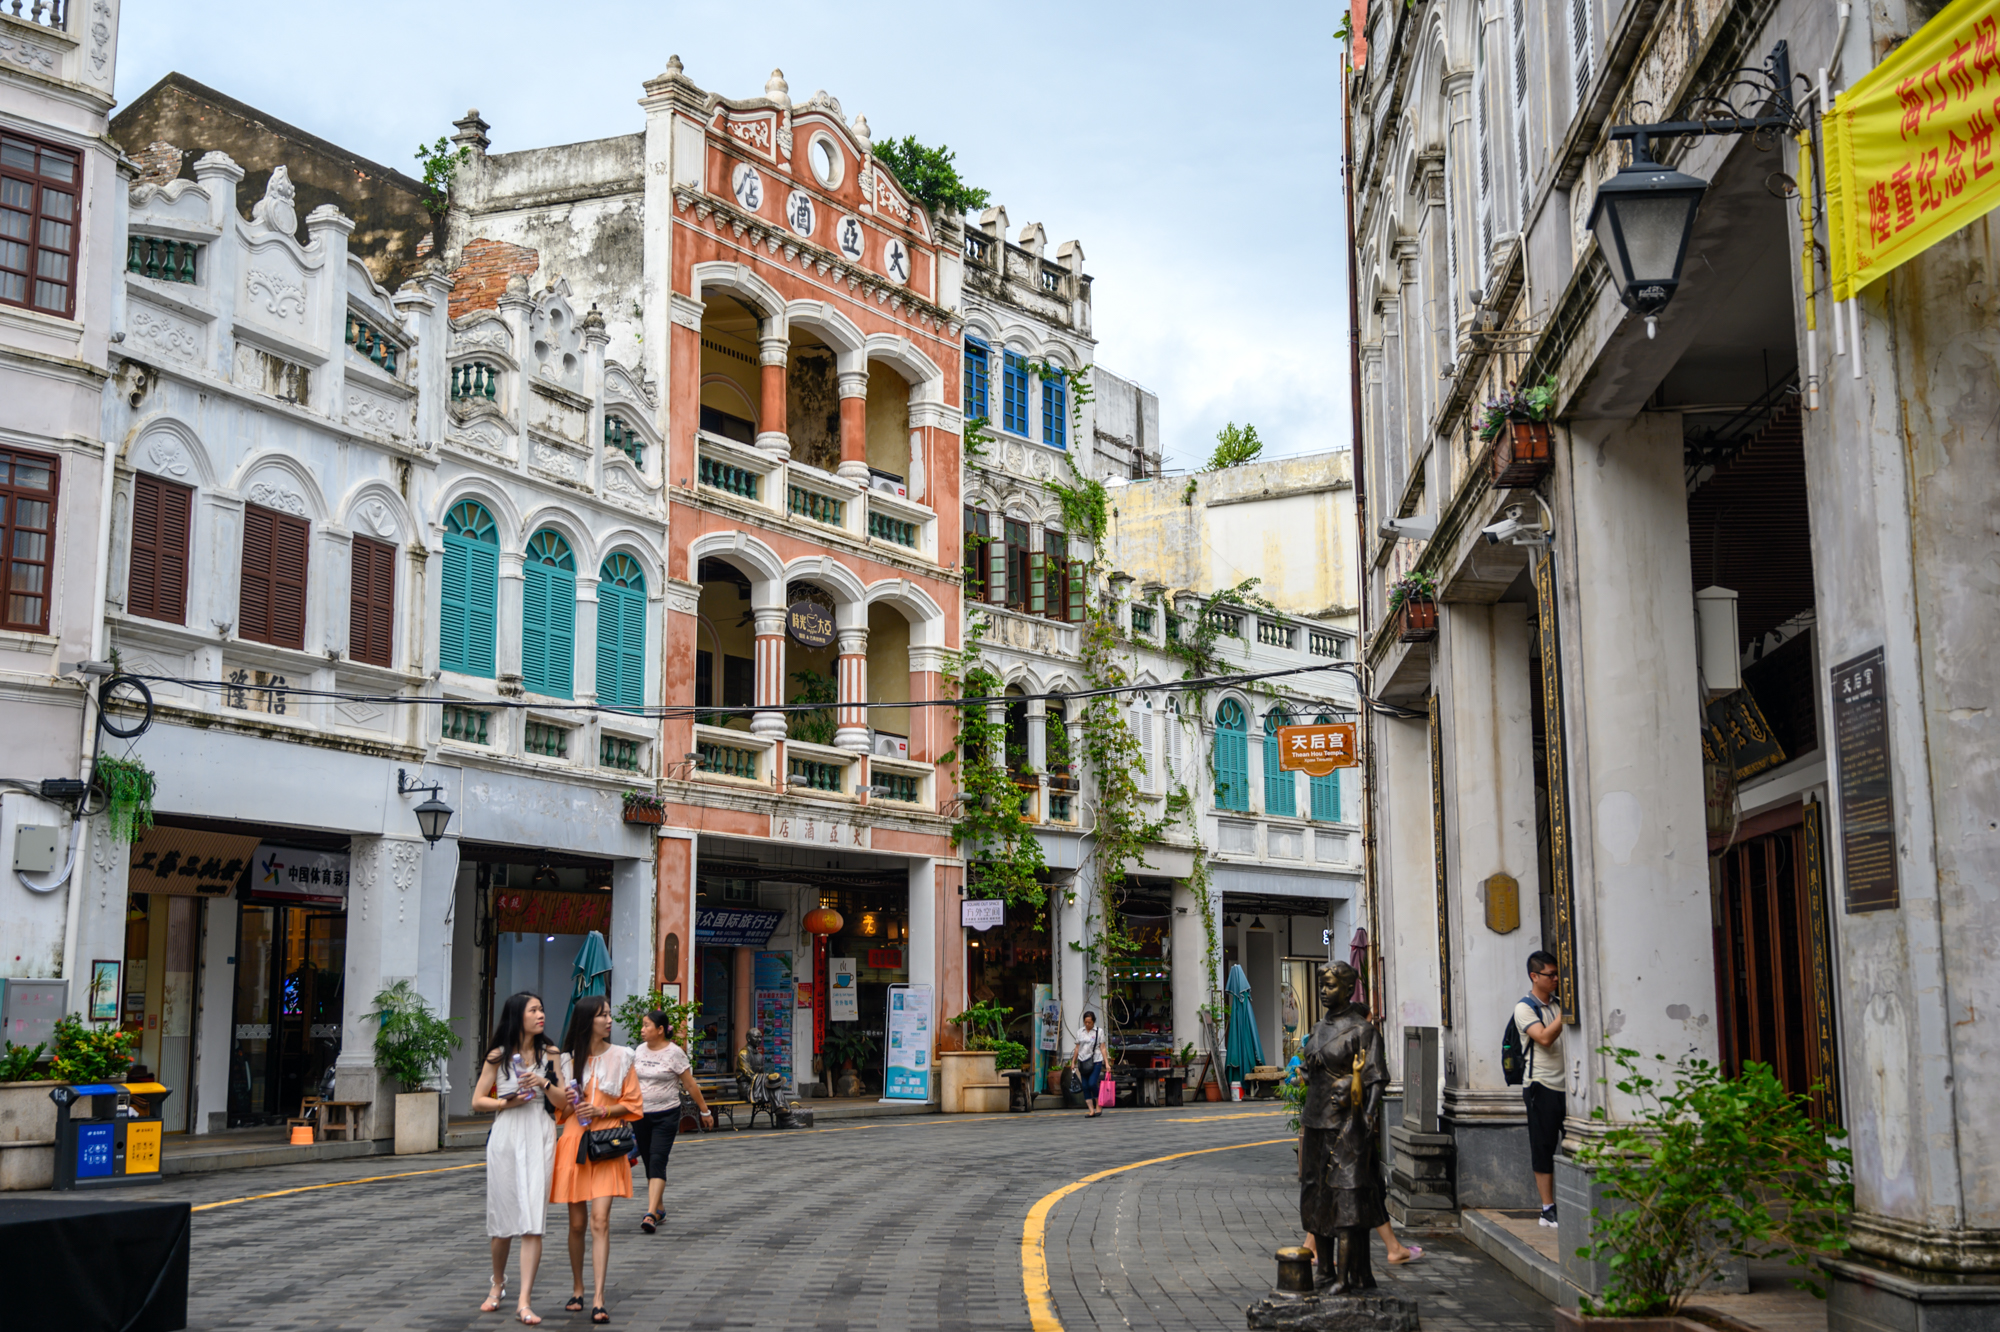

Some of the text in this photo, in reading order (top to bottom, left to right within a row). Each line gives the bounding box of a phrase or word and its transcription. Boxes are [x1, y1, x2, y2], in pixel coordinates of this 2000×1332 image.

[1868, 95, 2000, 250] 隆重纪念世
[1842, 668, 1874, 693] 天后宫
[1291, 732, 1344, 750] 天后宫
